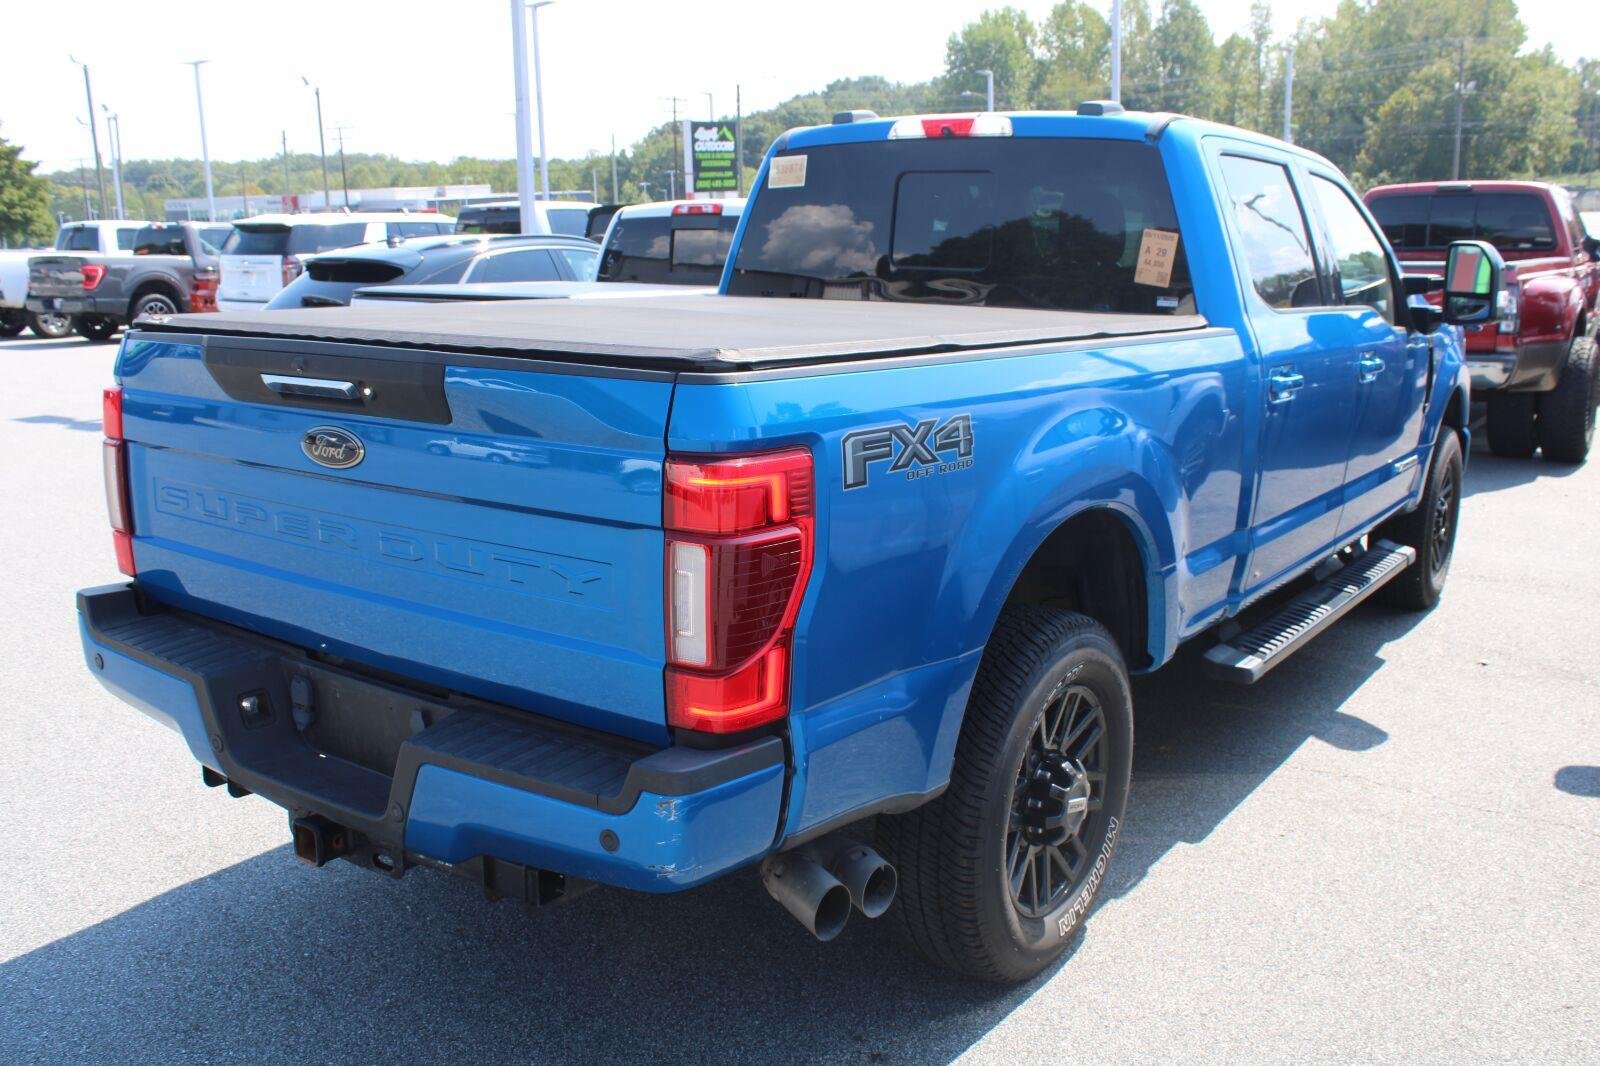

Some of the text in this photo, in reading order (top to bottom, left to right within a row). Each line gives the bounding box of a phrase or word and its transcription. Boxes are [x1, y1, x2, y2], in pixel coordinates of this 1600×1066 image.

[1155, 247, 1168, 258] 29
[841, 413, 974, 492] FX4
[905, 458, 974, 481] OFF ROAD
[158, 484, 602, 597] SUPER DUTY
[1058, 816, 1119, 937] MICHELIN
